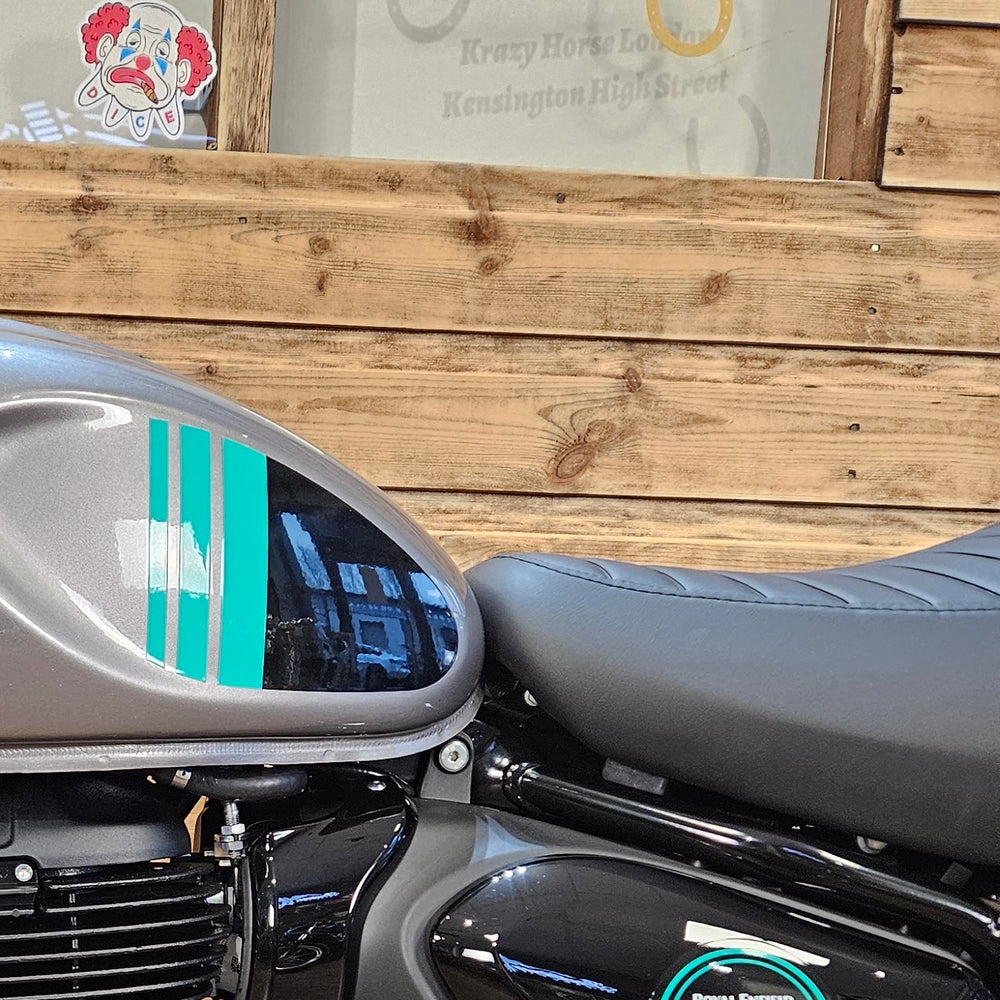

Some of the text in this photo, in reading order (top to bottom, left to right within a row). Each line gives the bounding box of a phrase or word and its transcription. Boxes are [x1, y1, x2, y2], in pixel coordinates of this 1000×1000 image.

[460, 38, 537, 69] Krazy
[540, 32, 616, 59] Horse
[86, 86, 175, 126] DICE
[442, 68, 730, 119] Kensington High Street
